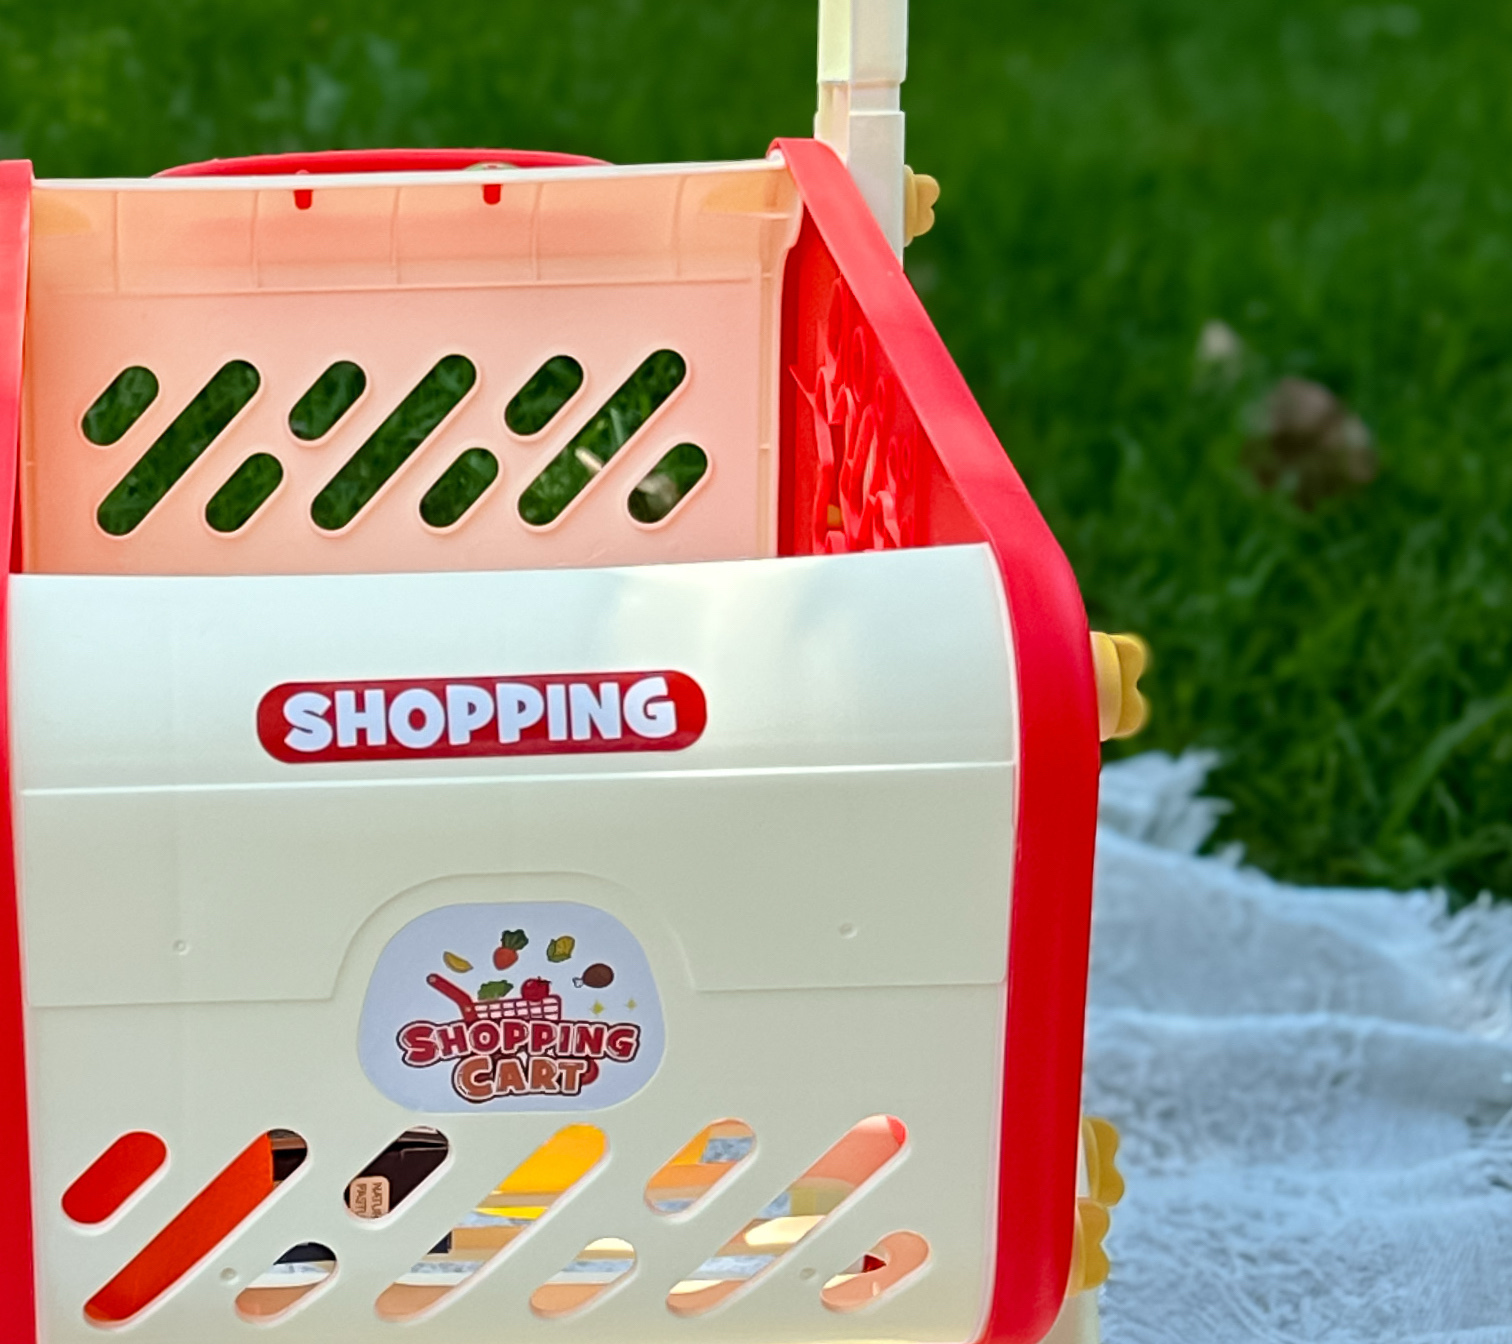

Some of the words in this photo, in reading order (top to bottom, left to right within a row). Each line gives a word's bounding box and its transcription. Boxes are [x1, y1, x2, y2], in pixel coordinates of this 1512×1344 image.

[283, 677, 677, 752] SHOPPING
[397, 1020, 640, 1067] SHOPPING
[452, 1055, 589, 1102] CART
